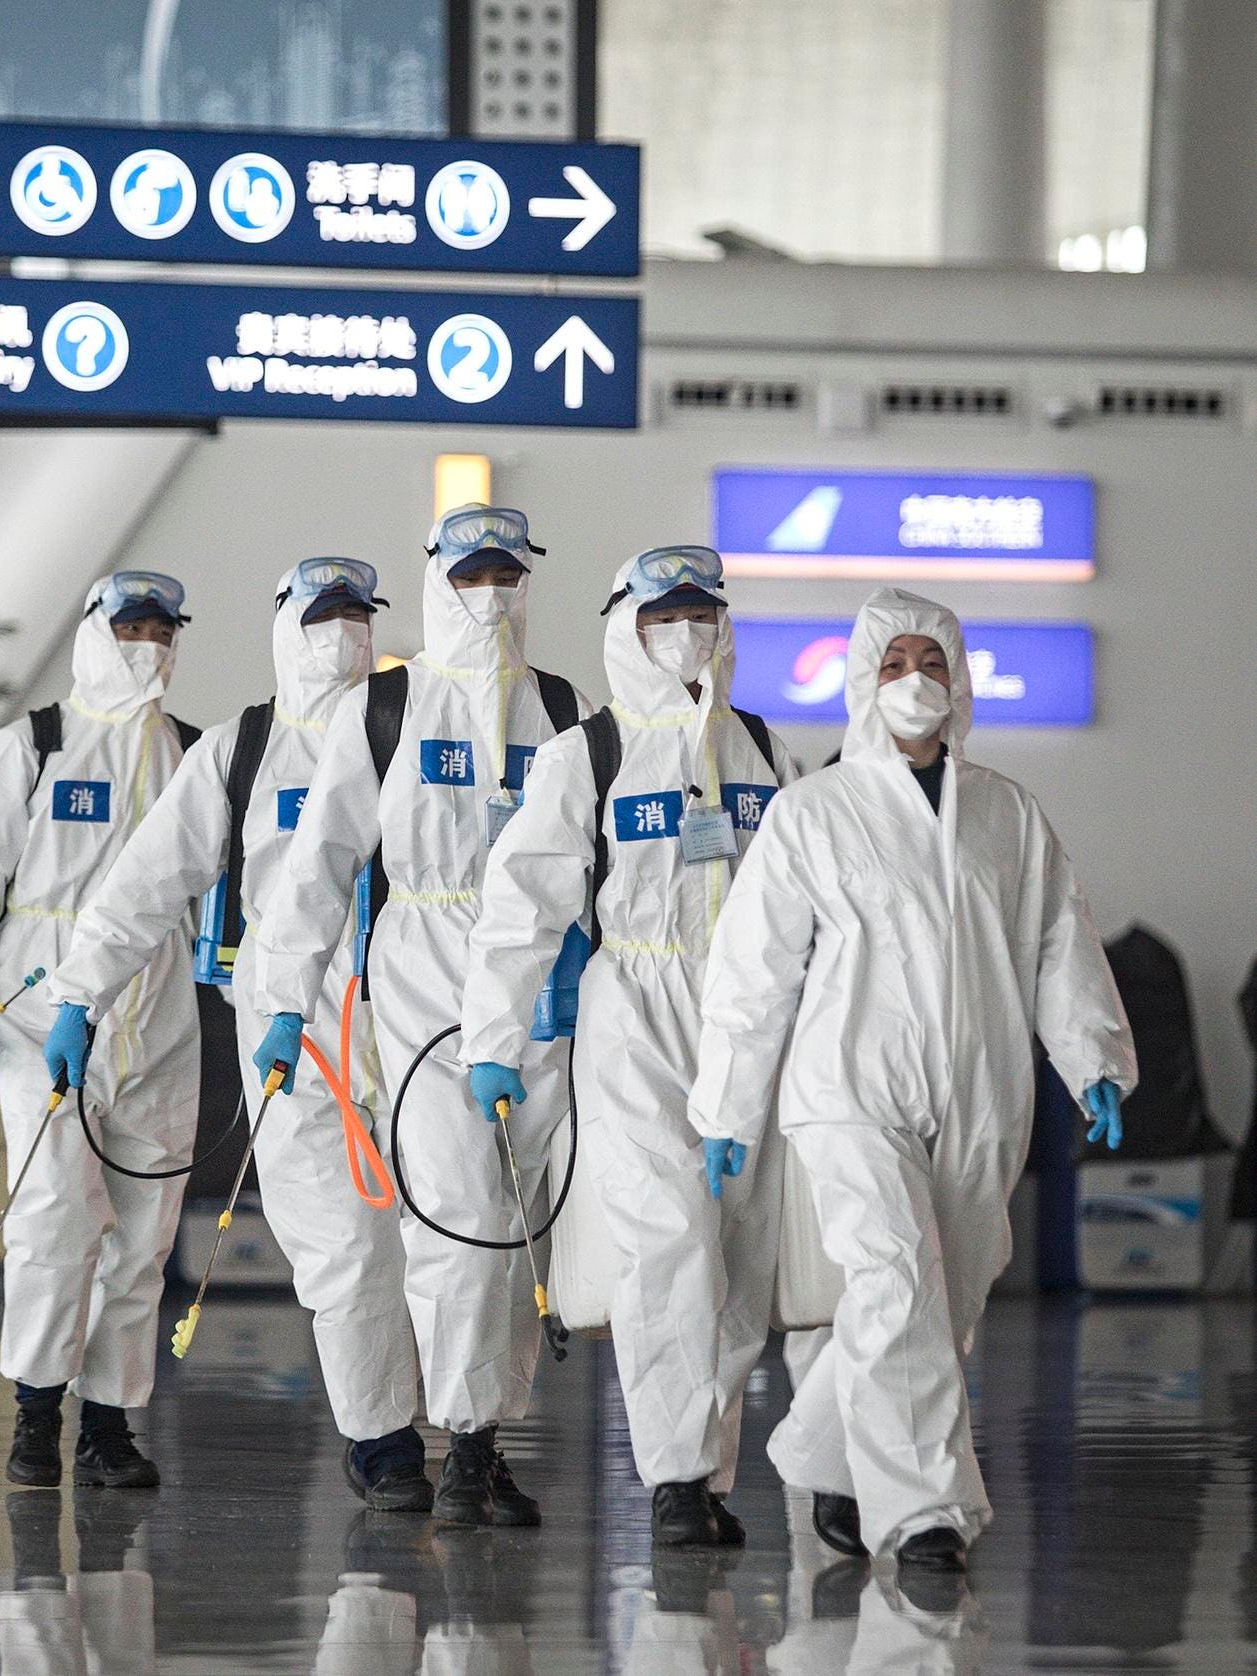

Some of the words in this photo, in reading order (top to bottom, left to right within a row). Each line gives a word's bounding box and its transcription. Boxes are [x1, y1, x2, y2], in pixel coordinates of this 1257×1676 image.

[313, 205, 417, 244] Toilets
[206, 355, 264, 392] VIP
[264, 357, 418, 401] Reception
[440, 748, 467, 778] 消
[69, 786, 95, 816] 消
[634, 801, 666, 832] 消
[737, 791, 763, 825] 防
